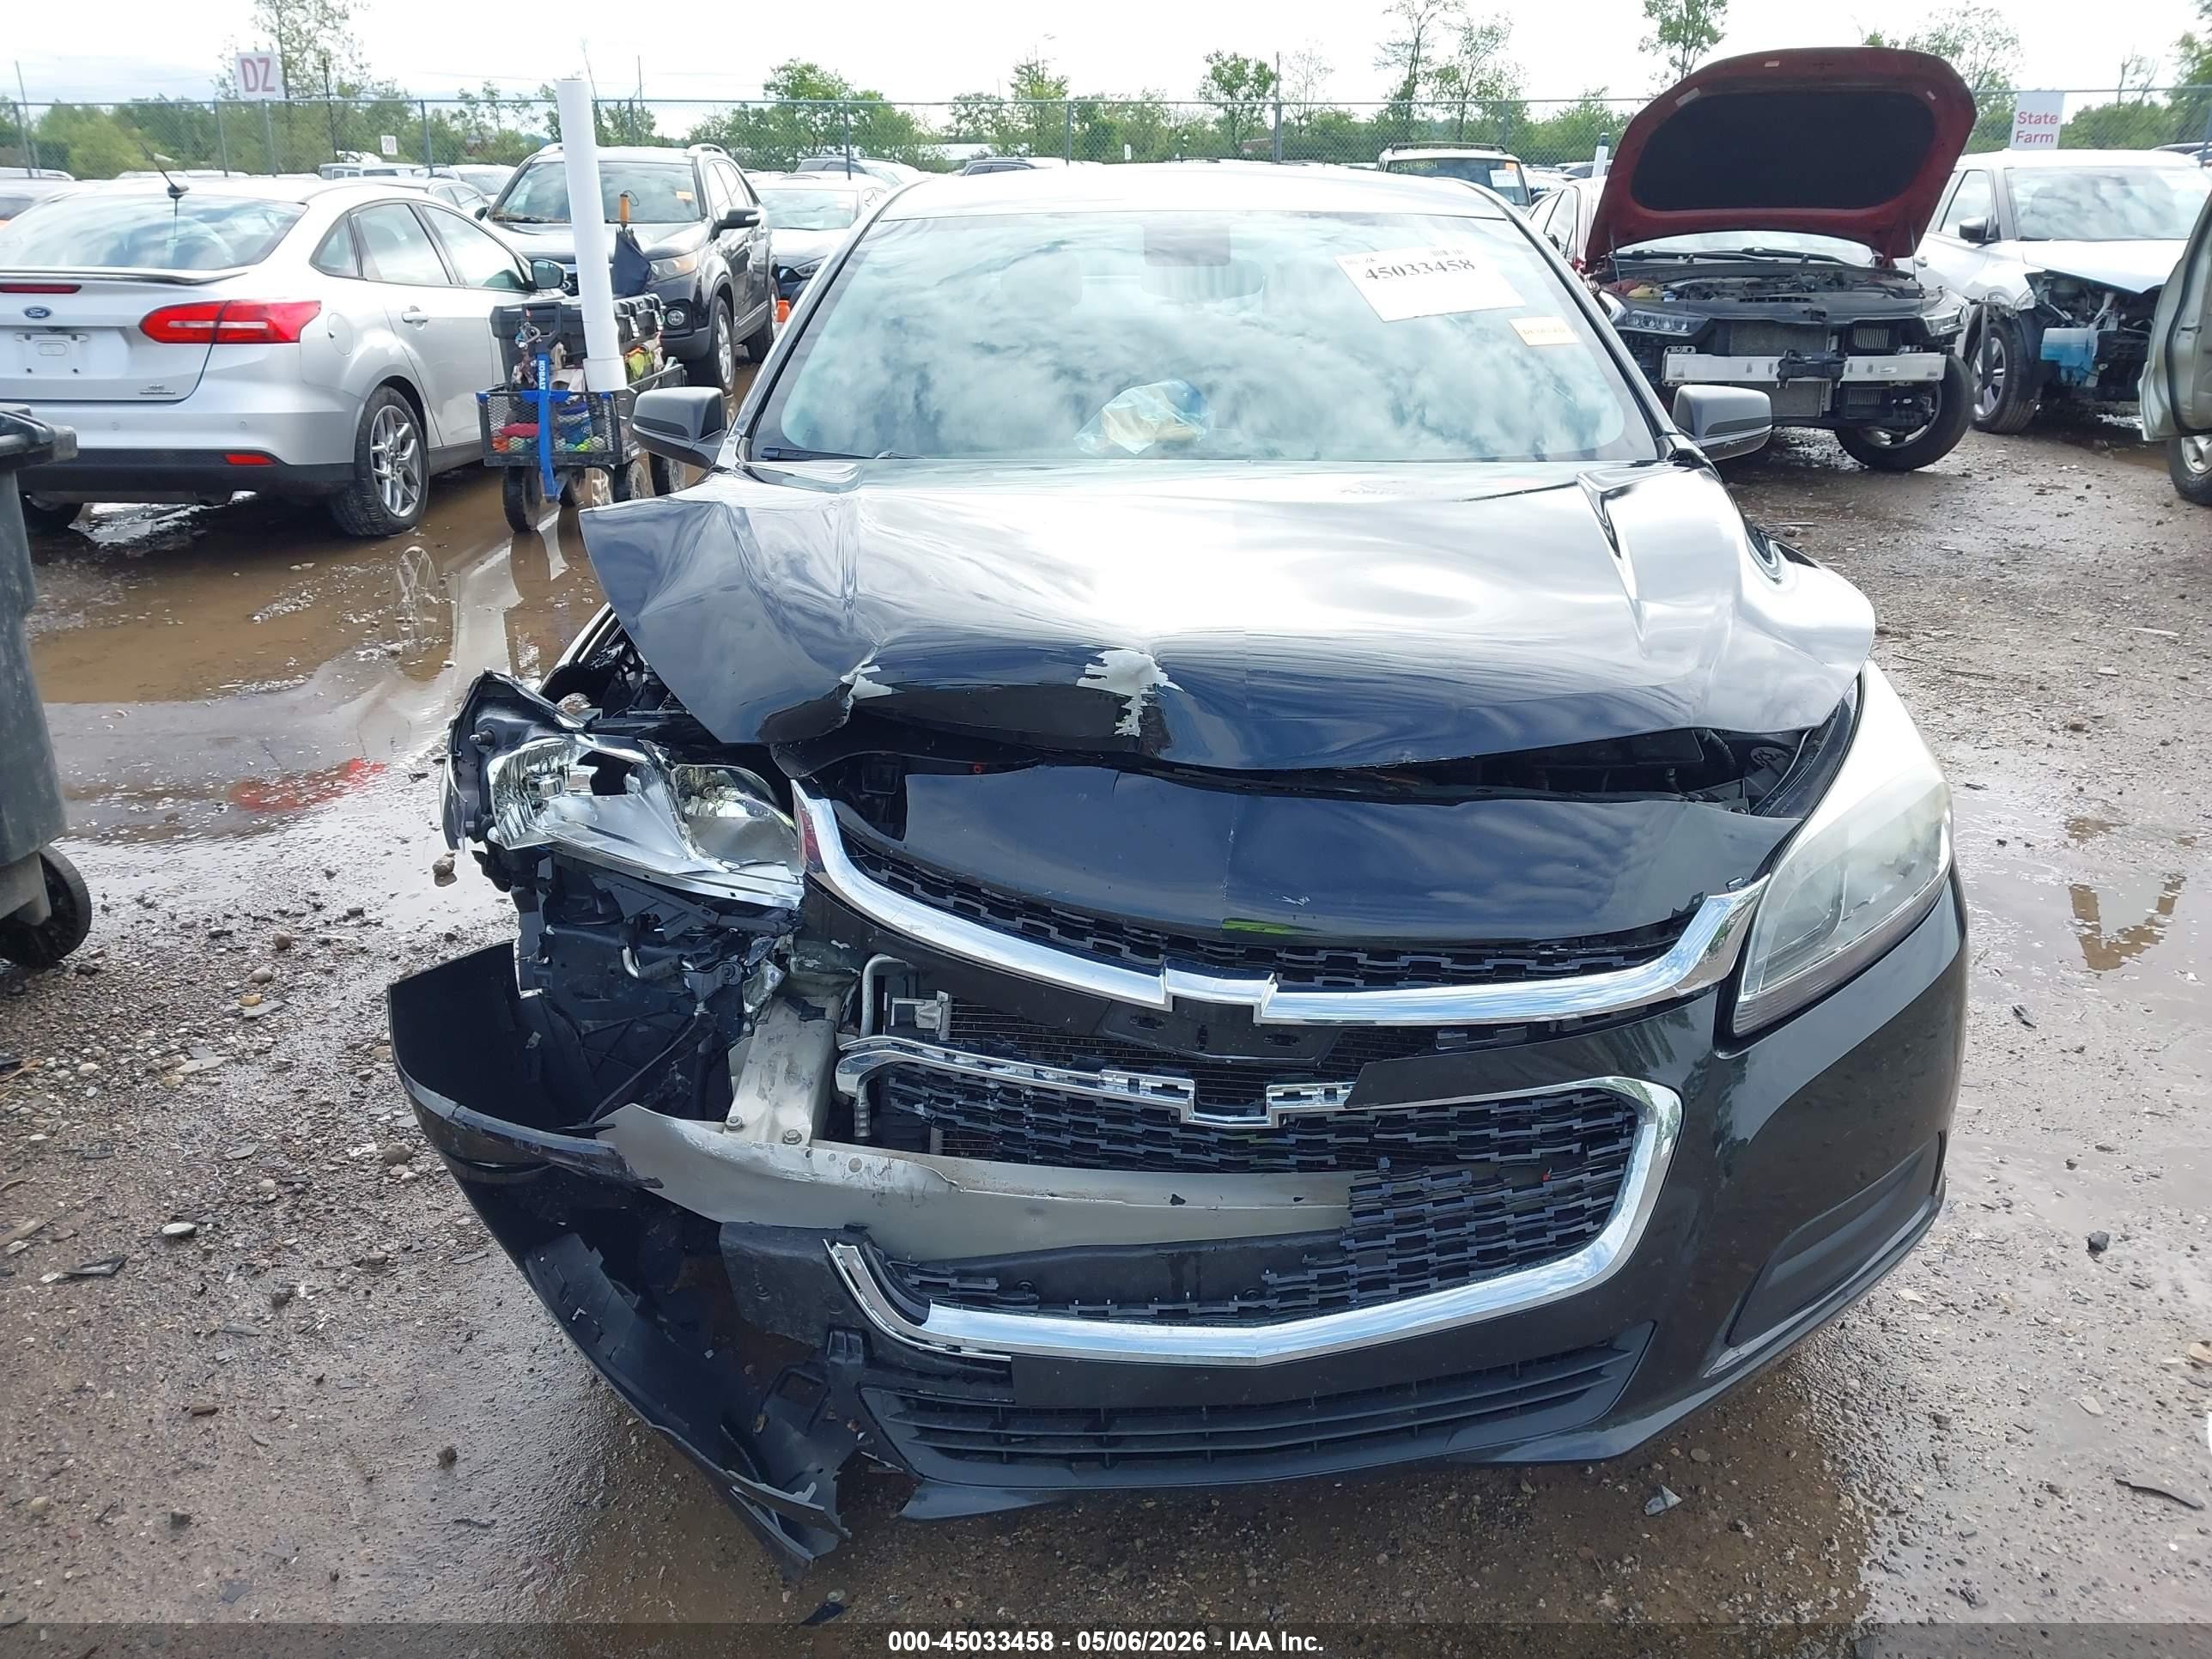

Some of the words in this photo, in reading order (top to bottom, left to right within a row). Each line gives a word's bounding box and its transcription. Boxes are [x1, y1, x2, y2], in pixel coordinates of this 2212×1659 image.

[240, 58, 276, 92] DZ
[2018, 111, 2058, 125] State
[2015, 131, 2054, 143] Farm
[1365, 258, 1476, 280] 45033458
